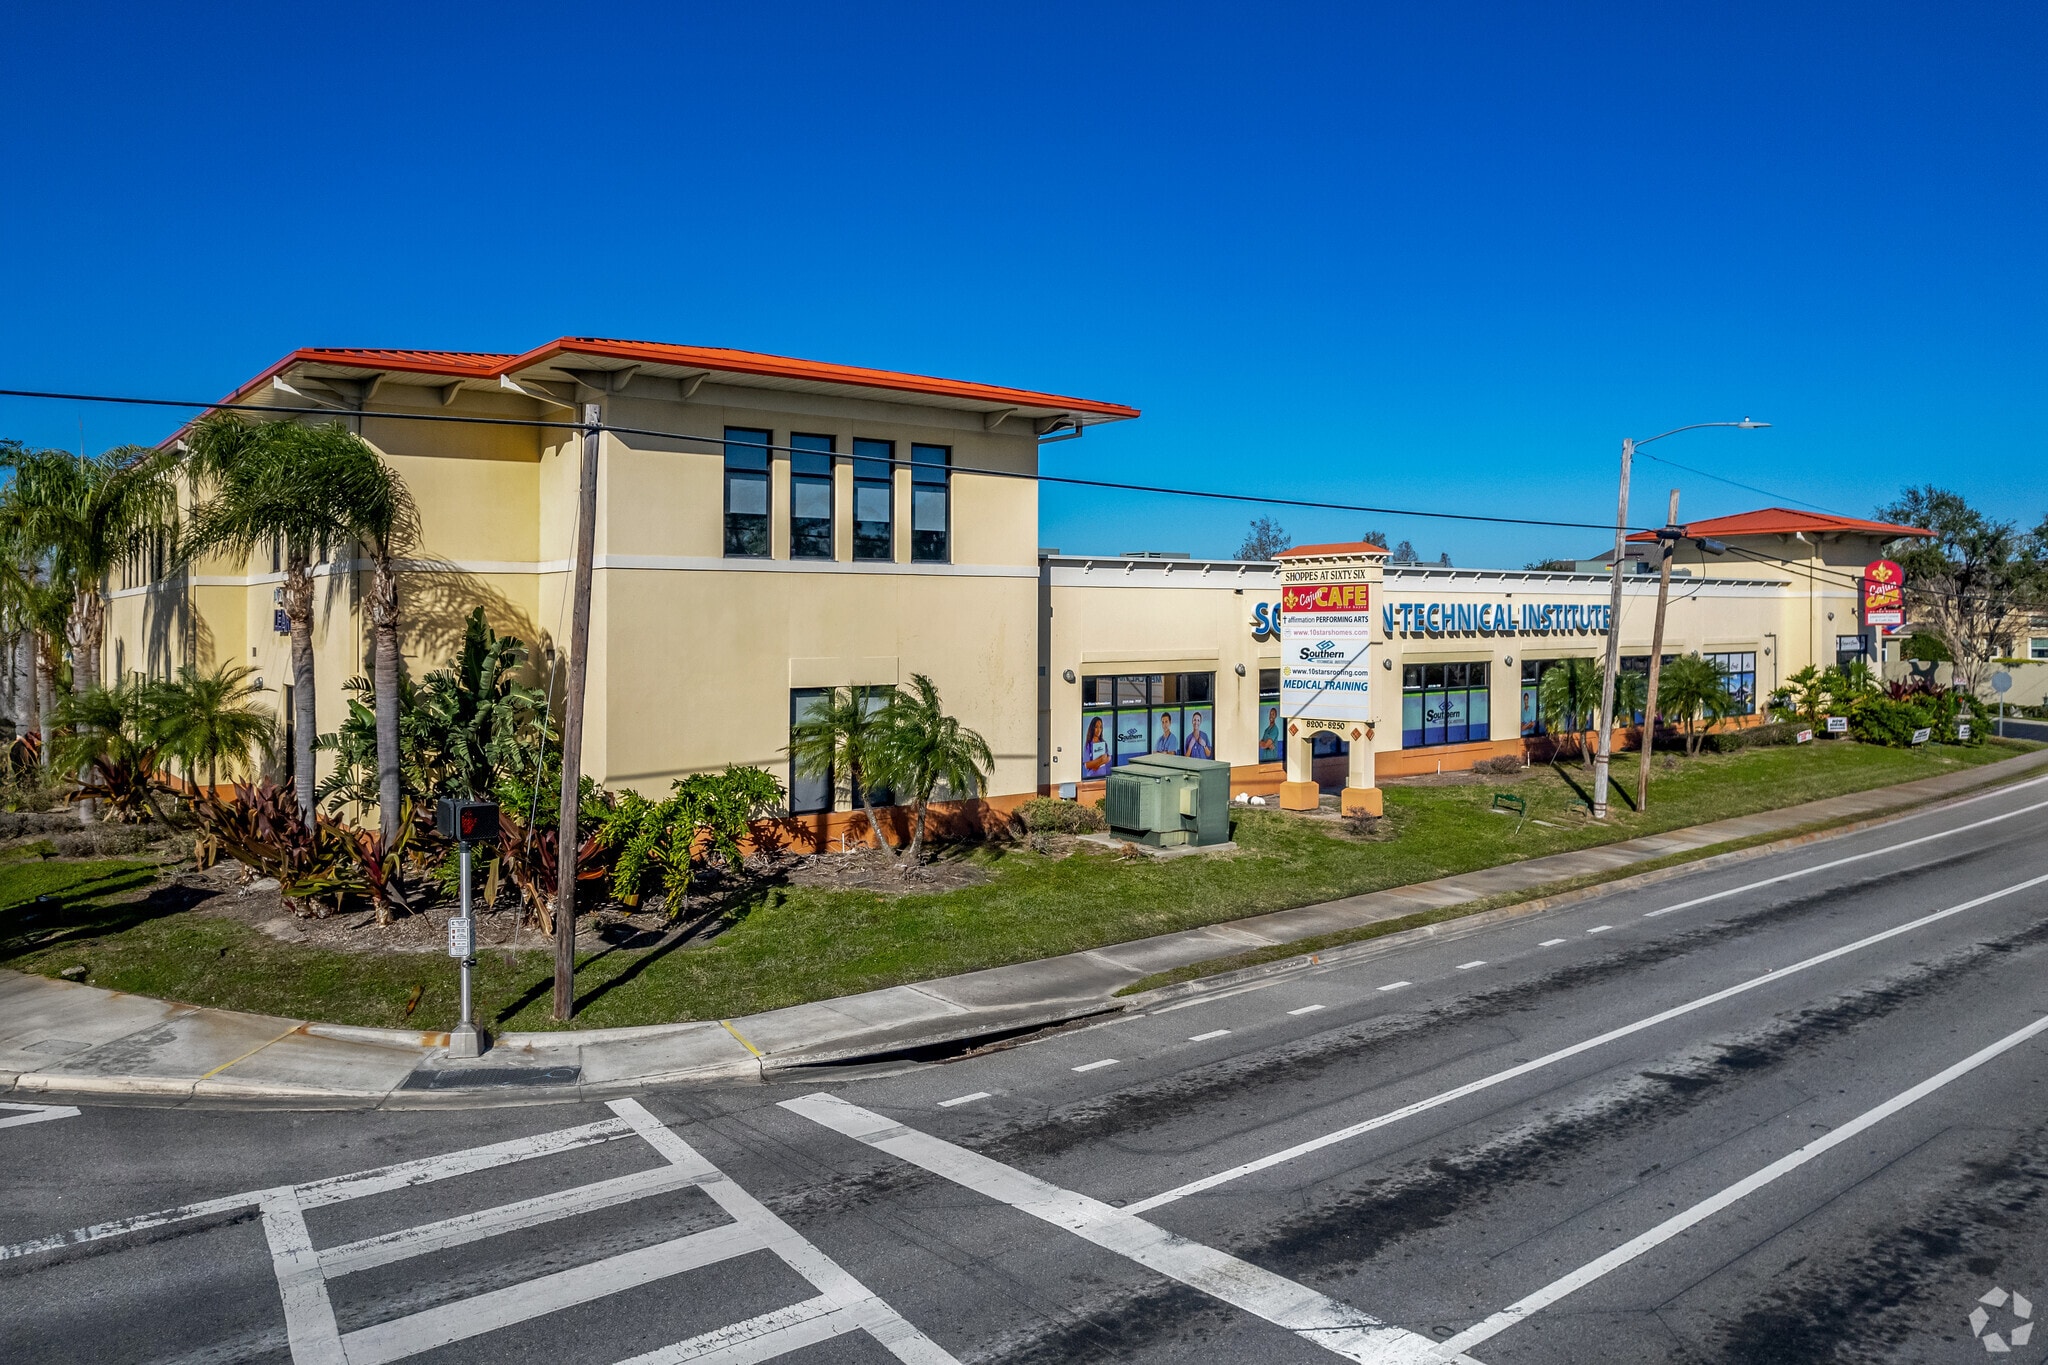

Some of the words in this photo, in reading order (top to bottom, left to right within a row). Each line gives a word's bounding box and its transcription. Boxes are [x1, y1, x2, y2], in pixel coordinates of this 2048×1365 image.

[1285, 571, 1319, 582] SHOPPES
[1320, 571, 1330, 580] AT
[1330, 570, 1353, 580] SIXTY
[1353, 569, 1366, 579] SIX
[1869, 581, 1897, 599] Cajun
[1299, 589, 1323, 610] Cajun
[1315, 585, 1368, 607] CAFE
[1287, 616, 1316, 624] affirmation
[1316, 615, 1353, 623] PERFORMING
[1353, 615, 1369, 623] ARTS
[1399, 603, 1518, 632] TECHNICAL
[1522, 603, 1611, 631] INSTITUTE
[1293, 628, 1369, 636] www.10starshomes.com
[1299, 647, 1345, 660] Southern
[1292, 667, 1369, 678] www.10starsroofing.com
[1283, 679, 1322, 690] MEDICAL
[1324, 681, 1369, 692] TRAINING
[1426, 709, 1460, 722] Soutern
